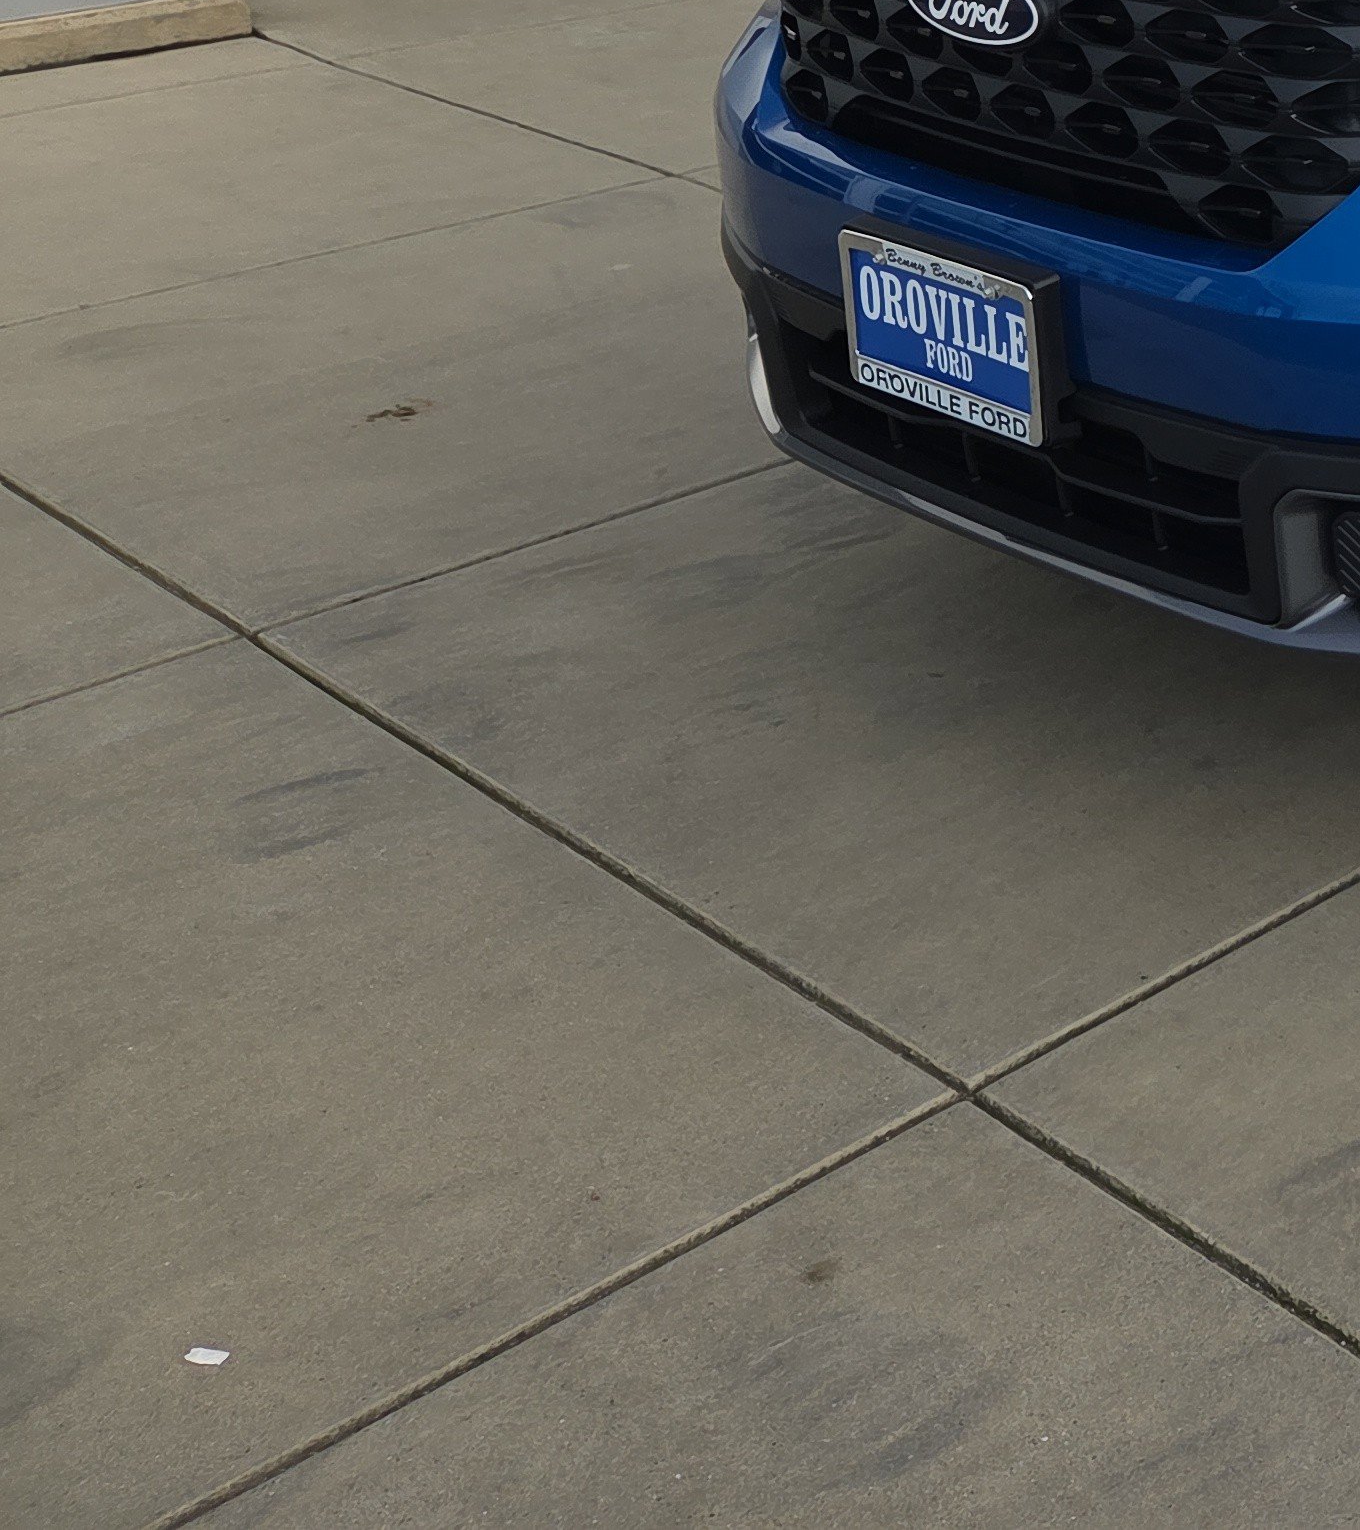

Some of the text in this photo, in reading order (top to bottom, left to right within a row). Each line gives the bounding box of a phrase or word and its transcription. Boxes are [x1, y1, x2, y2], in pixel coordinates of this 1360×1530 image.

[885, 247, 985, 290] Benny Brown's
[859, 265, 1029, 373] OROVILLE
[923, 338, 974, 383] FORD
[860, 363, 1028, 439] OROVILLE FORD
